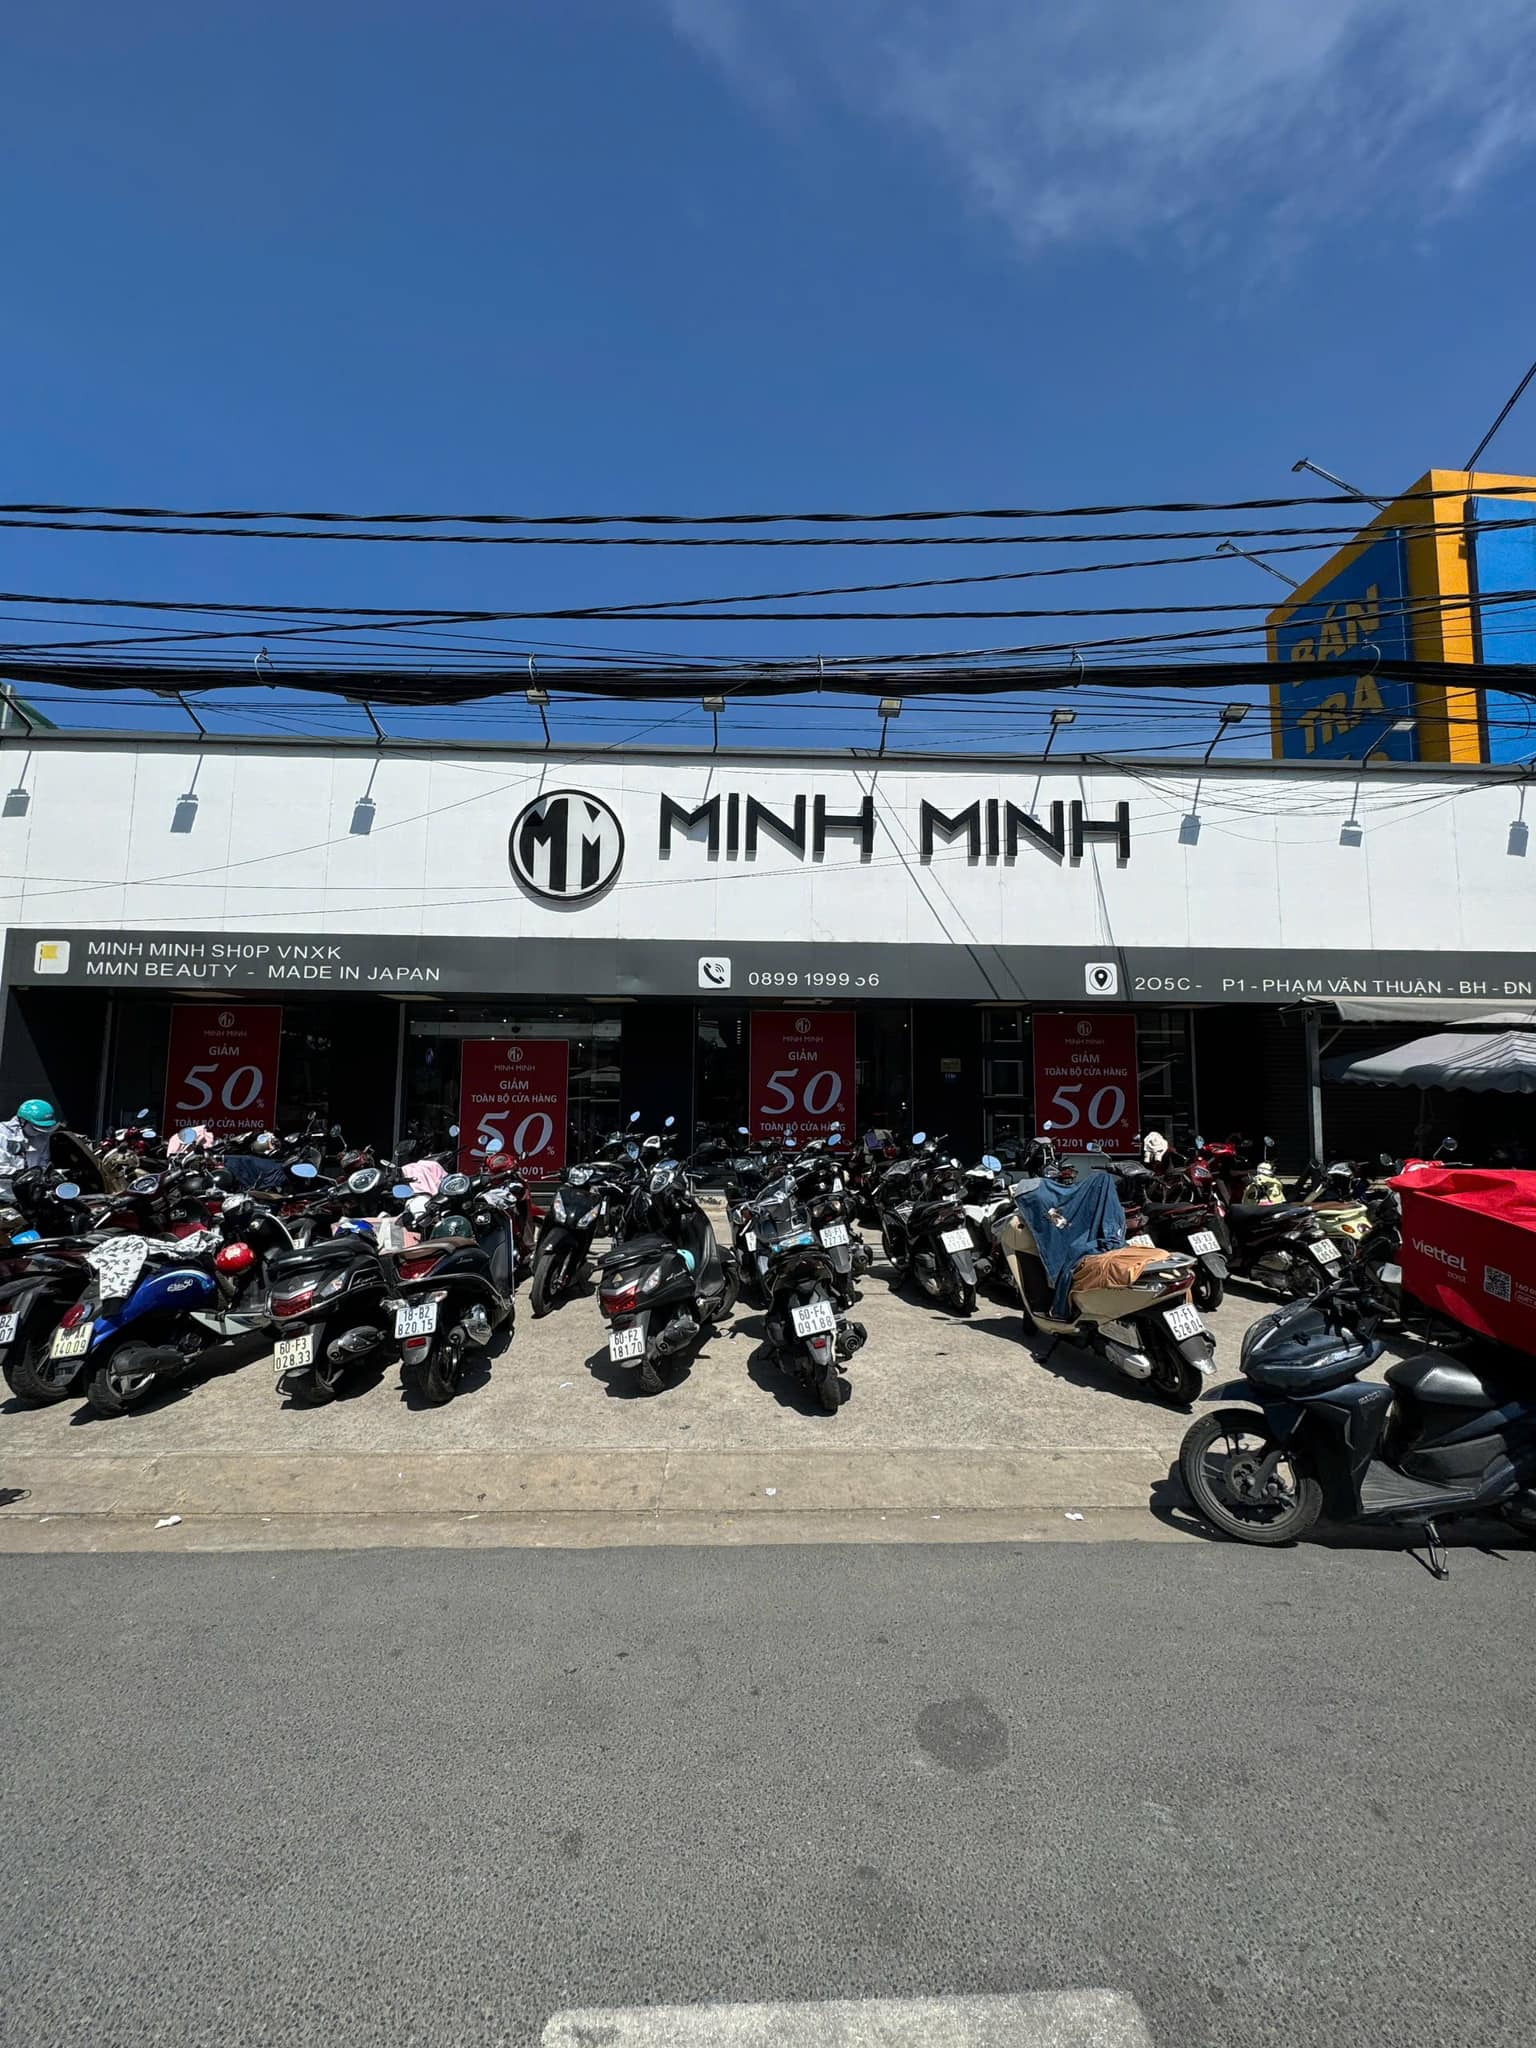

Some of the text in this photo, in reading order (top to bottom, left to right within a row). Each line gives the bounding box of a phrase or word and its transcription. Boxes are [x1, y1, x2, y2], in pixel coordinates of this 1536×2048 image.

[660, 792, 1130, 860] MINH MINH
[88, 942, 143, 956] MINH
[150, 943, 205, 957] MINH
[277, 945, 341, 960] VNXK
[86, 961, 138, 976] MMN
[145, 962, 238, 977] BEAUTY
[268, 965, 333, 979] MADE
[340, 966, 360, 980] IN
[367, 967, 440, 981] JAPAN
[748, 972, 798, 986] 0899
[803, 972, 850, 986] 1999
[1222, 978, 1244, 992] P1
[1262, 979, 1322, 995] PHẠM
[1327, 976, 1367, 993] VĂN
[1371, 977, 1441, 996] THUẬN
[1459, 980, 1487, 994] BH
[1503, 981, 1532, 994] ĐN
[208, 1043, 240, 1056] GIẢM
[788, 1048, 818, 1061] GIẢM
[1071, 1050, 1100, 1063] GIẢM
[1044, 1066, 1068, 1076] TOÀN
[1069, 1066, 1082, 1077] BỘ
[1103, 1066, 1128, 1076] HÀNG
[499, 1078, 529, 1090] GIẢM
[471, 1093, 495, 1103] TOÀN
[497, 1092, 510, 1104] BỘ
[532, 1093, 557, 1104] HÀNG
[238, 1117, 265, 1128] HÀNG
[760, 1121, 784, 1131] TOÀN
[1057, 1138, 1083, 1148] 12/01
[1411, 1238, 1468, 1272] viettel
[798, 1305, 826, 1321] 60-F4
[276, 1350, 311, 1370] 028.33
